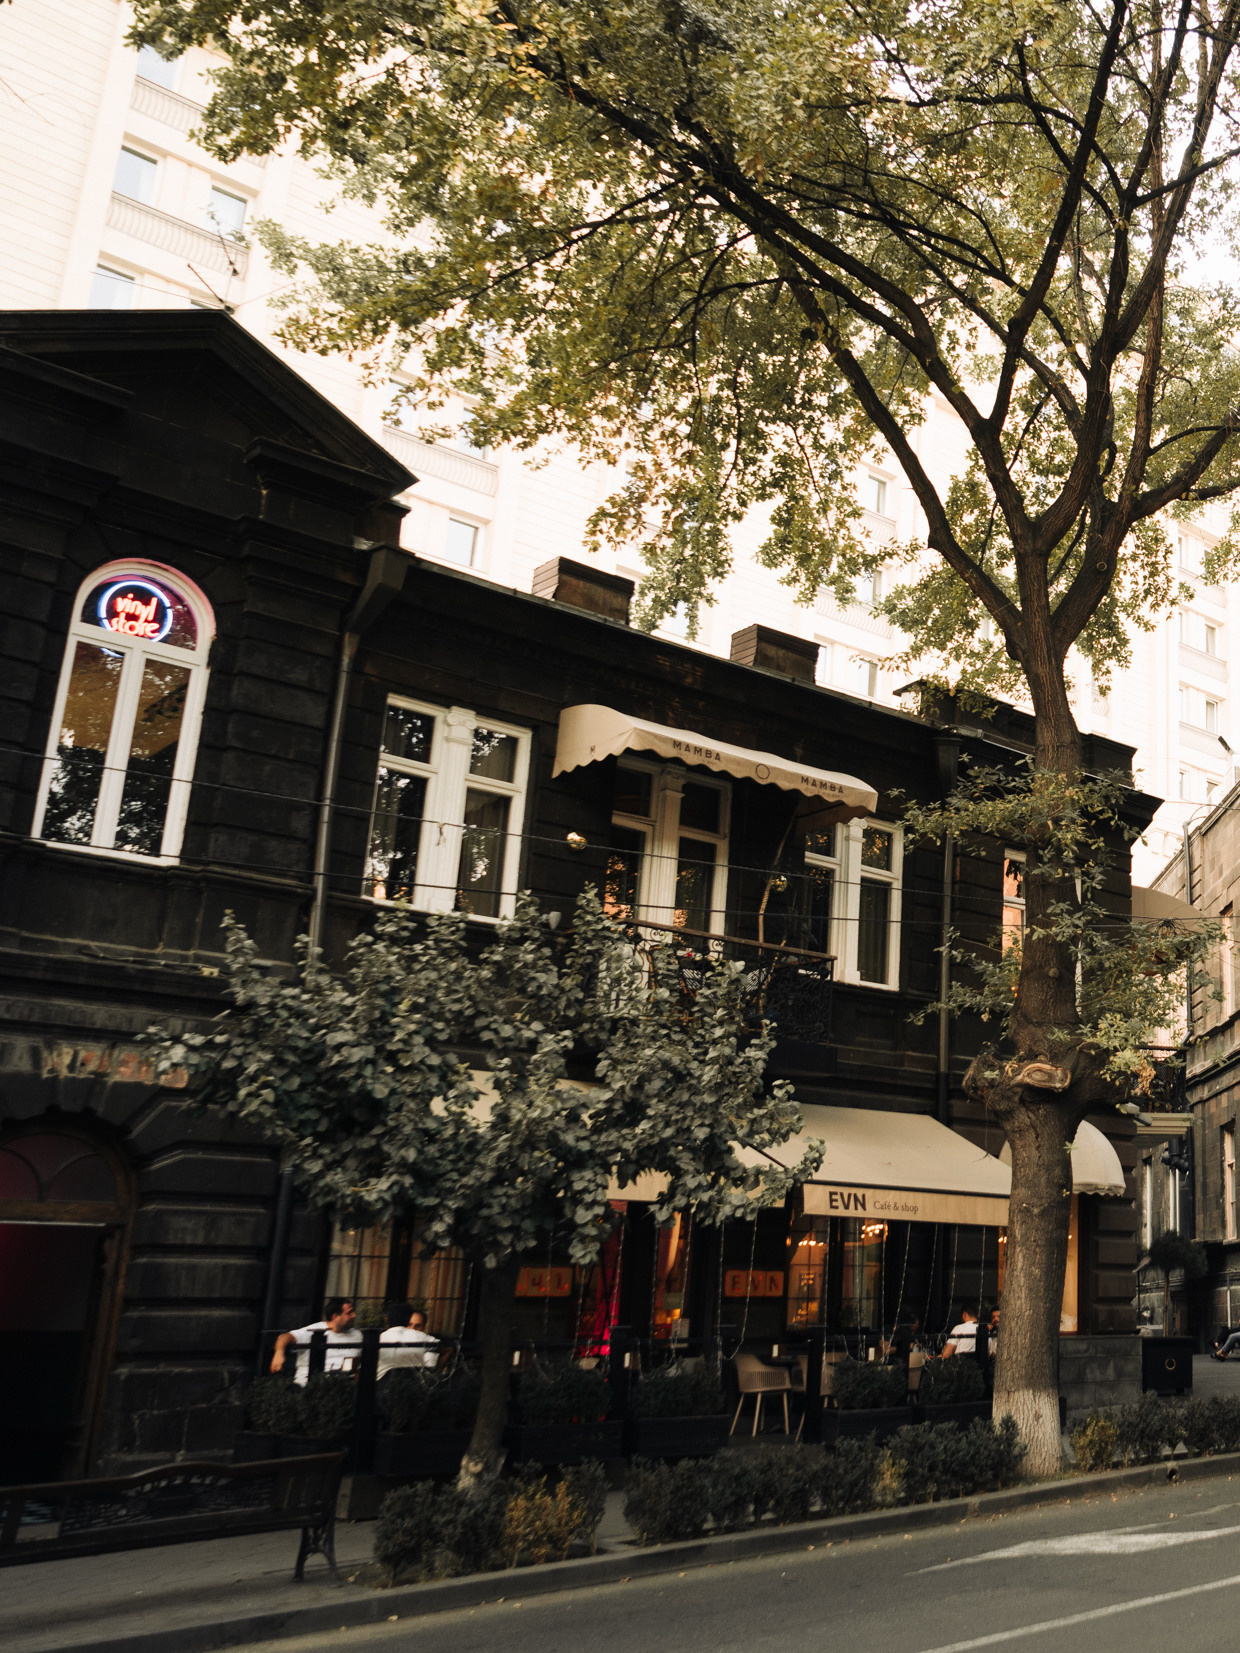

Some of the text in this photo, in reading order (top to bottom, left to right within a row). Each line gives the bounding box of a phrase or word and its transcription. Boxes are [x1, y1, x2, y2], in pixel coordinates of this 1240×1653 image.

[115, 592, 159, 624] vinyl
[110, 612, 160, 638] store
[673, 740, 722, 761] MAMBA
[801, 775, 844, 794] MAMBA
[828, 1191, 919, 1215] EVN Café & shop
[731, 1273, 781, 1293] EVN
